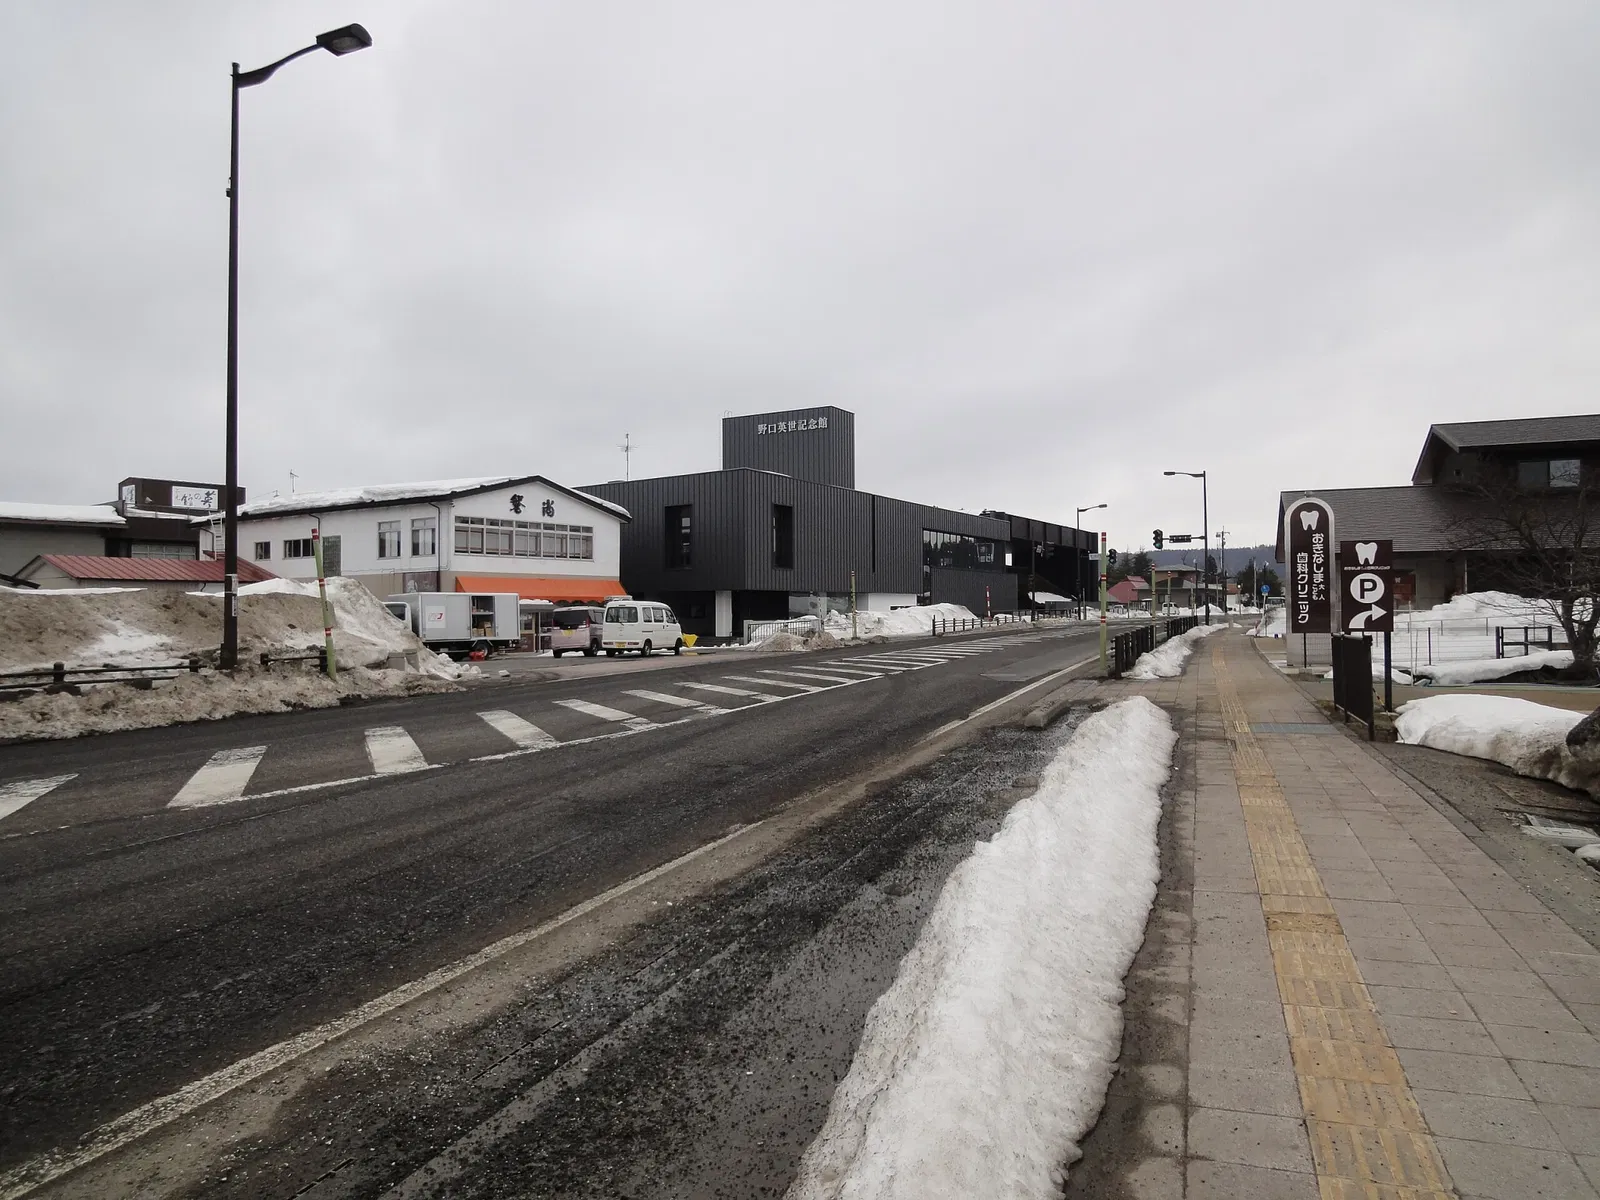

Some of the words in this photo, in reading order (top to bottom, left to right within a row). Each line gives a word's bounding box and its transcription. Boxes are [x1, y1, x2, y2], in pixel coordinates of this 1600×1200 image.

[757, 416, 828, 436] 野口英世記念館
[1312, 533, 1325, 583] おきなしま
[1296, 552, 1309, 624] 歯科クリニック
[1359, 578, 1378, 600] P
